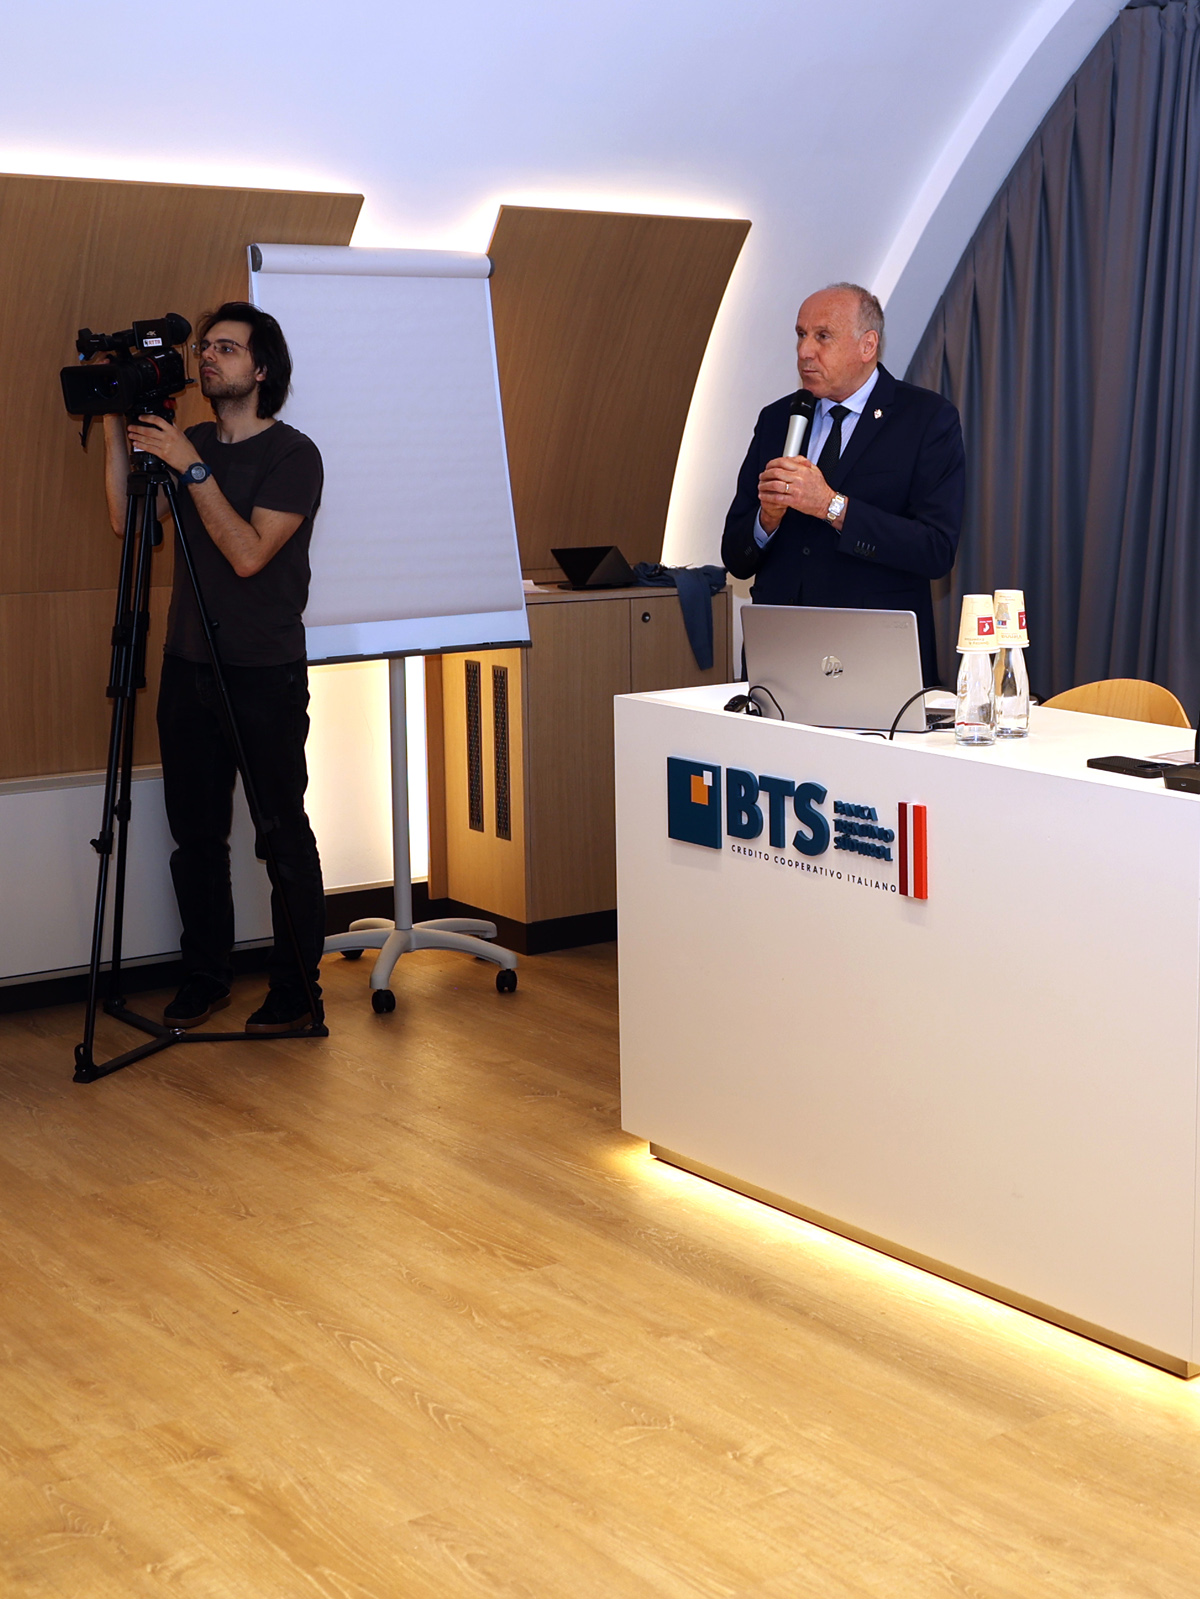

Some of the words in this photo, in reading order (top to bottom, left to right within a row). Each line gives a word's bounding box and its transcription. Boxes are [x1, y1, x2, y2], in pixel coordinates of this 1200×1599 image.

[822, 655, 844, 679] hp
[726, 768, 831, 857] BTS
[833, 800, 878, 822] BANCA
[832, 818, 895, 843] TRENTINO
[731, 844, 770, 861] CREDITO
[773, 856, 843, 880] COOPERATIVO
[847, 873, 897, 893] ITALIANO
